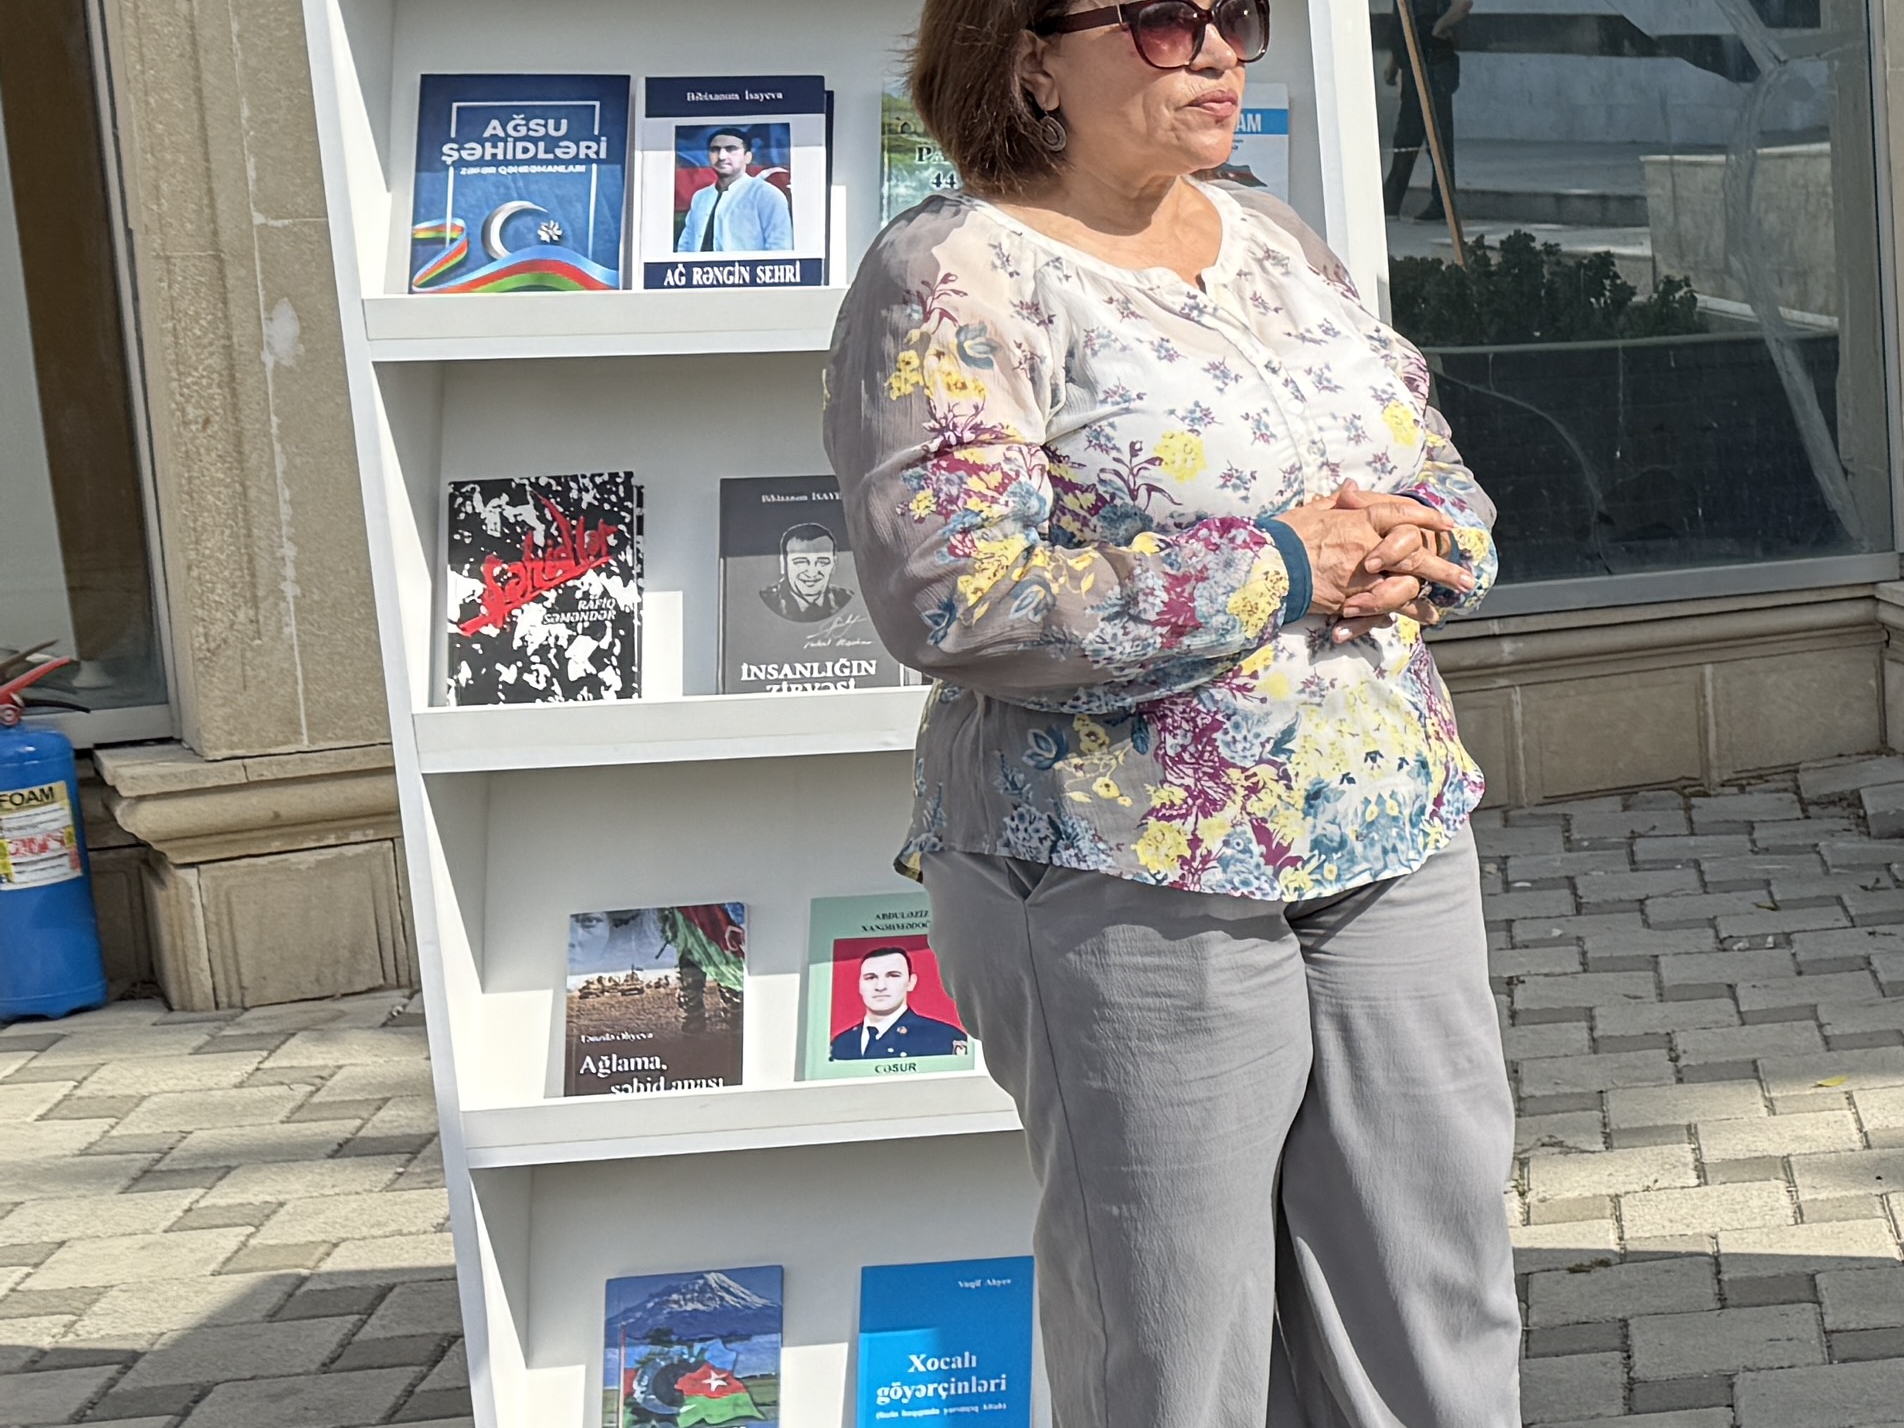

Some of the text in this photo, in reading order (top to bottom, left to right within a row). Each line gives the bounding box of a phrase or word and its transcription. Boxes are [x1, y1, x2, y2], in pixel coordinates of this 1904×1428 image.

[483, 114, 568, 138] AĞSU
[1236, 113, 1262, 132] AM
[441, 137, 607, 165] ŞƏHİDLƏRİ
[930, 170, 958, 190] 44
[664, 260, 801, 286] AĞ RƏNGİN SEHRİ
[741, 658, 877, 681] İNSANLIĞIN
[907, 1351, 977, 1373] Xocalı
[876, 1374, 1007, 1406] göyərçinləri
